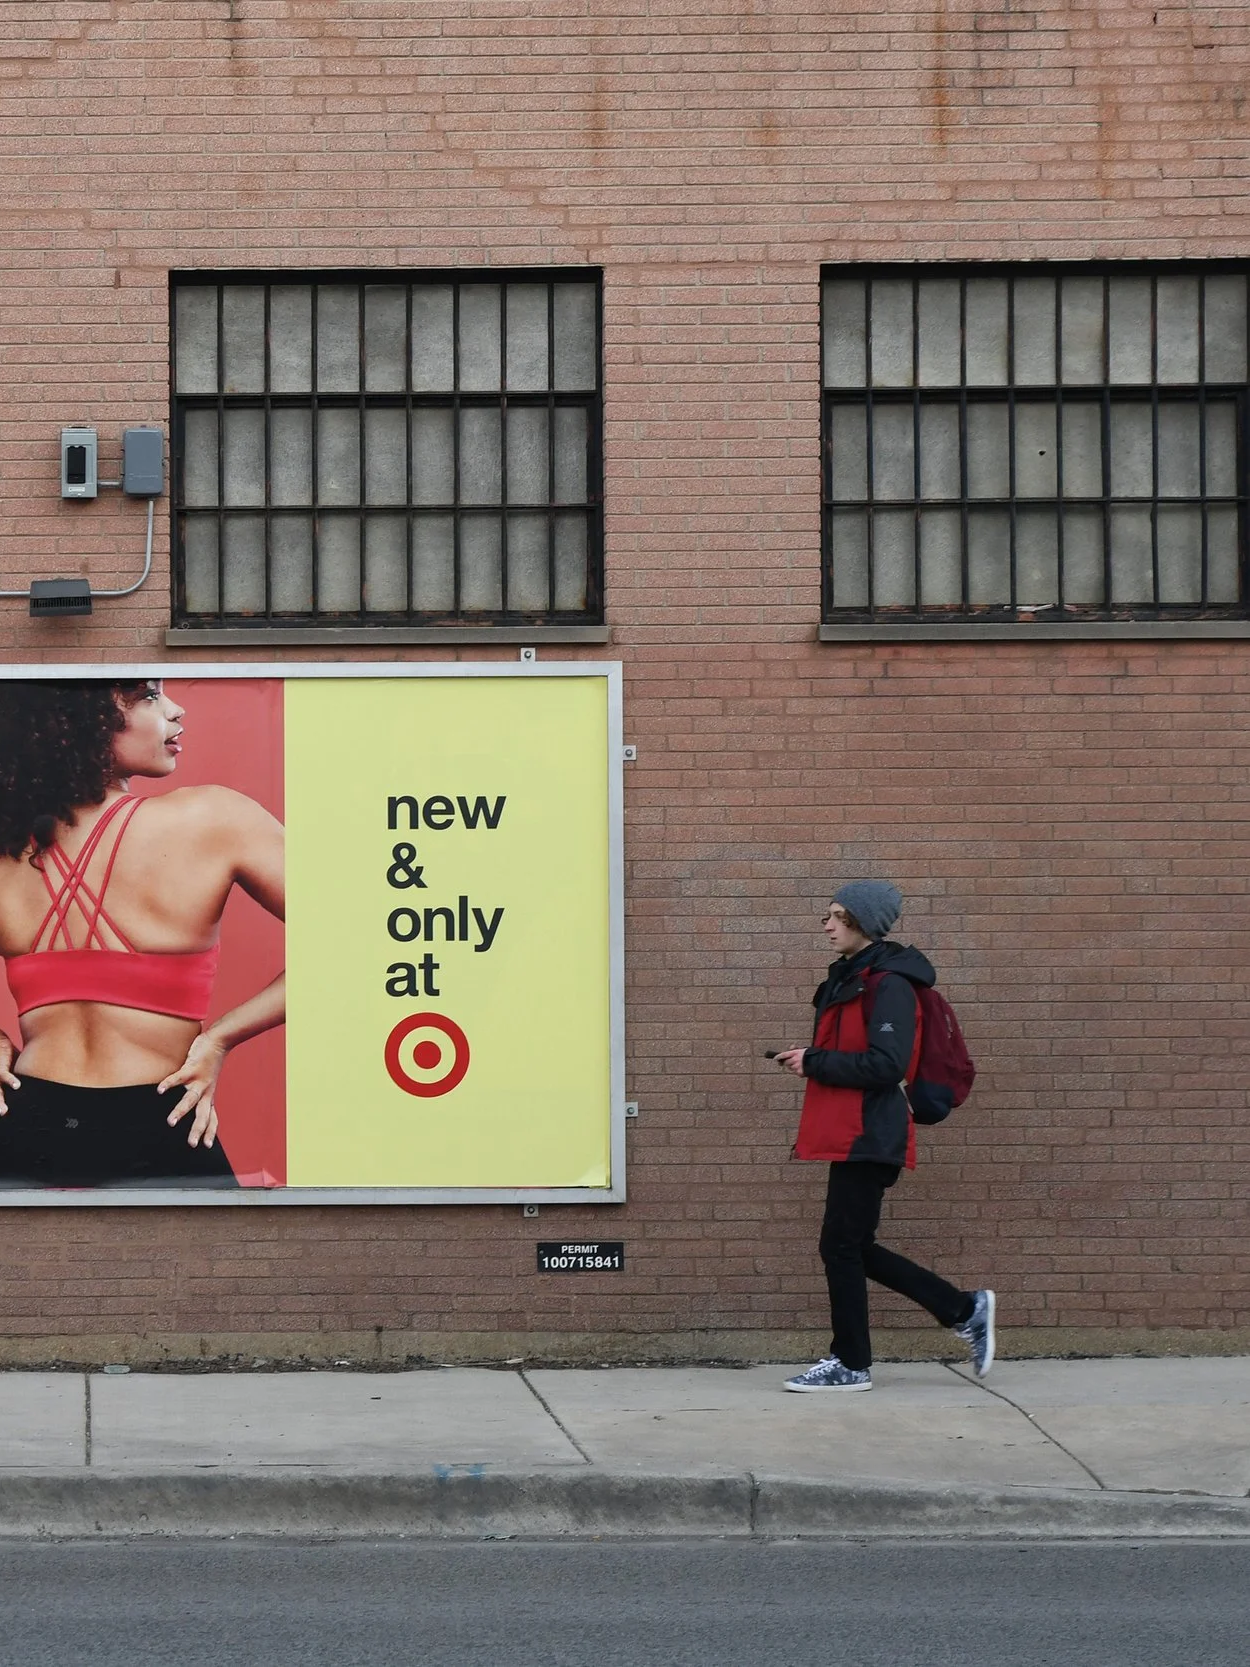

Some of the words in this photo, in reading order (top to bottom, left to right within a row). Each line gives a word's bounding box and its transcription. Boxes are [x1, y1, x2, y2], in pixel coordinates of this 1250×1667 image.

[387, 795, 507, 831] new
[386, 841, 429, 890] &
[386, 895, 506, 953] only
[385, 952, 441, 998] at
[542, 1256, 619, 1268] 100715841
[561, 1245, 599, 1254] PERMIT
